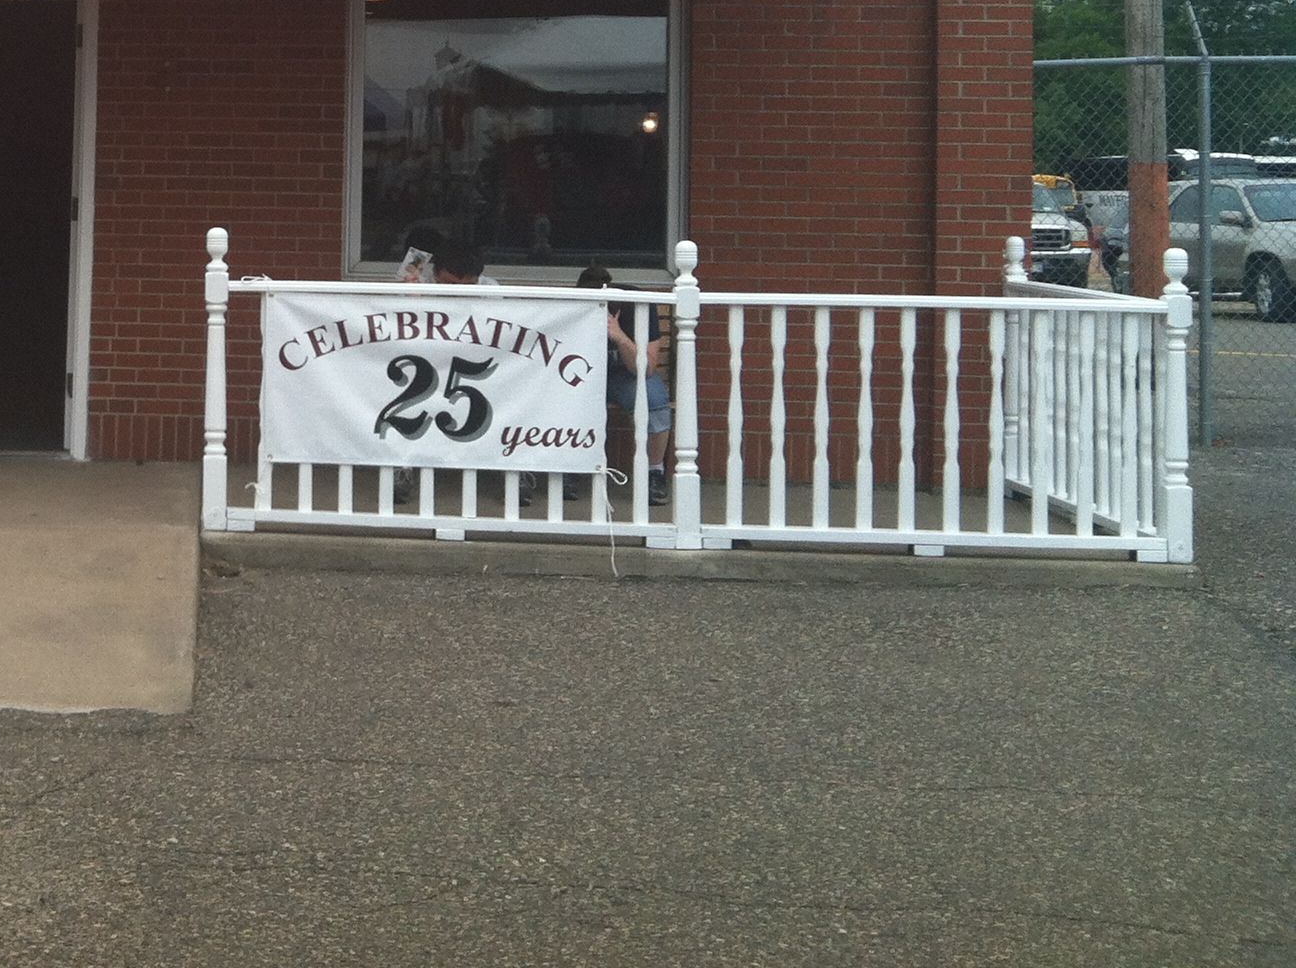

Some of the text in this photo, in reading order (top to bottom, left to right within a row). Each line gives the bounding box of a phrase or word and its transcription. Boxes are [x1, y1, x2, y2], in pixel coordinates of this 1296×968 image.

[278, 310, 592, 387] CELEBRATING
[373, 354, 499, 443] 25
[500, 424, 596, 456] years
